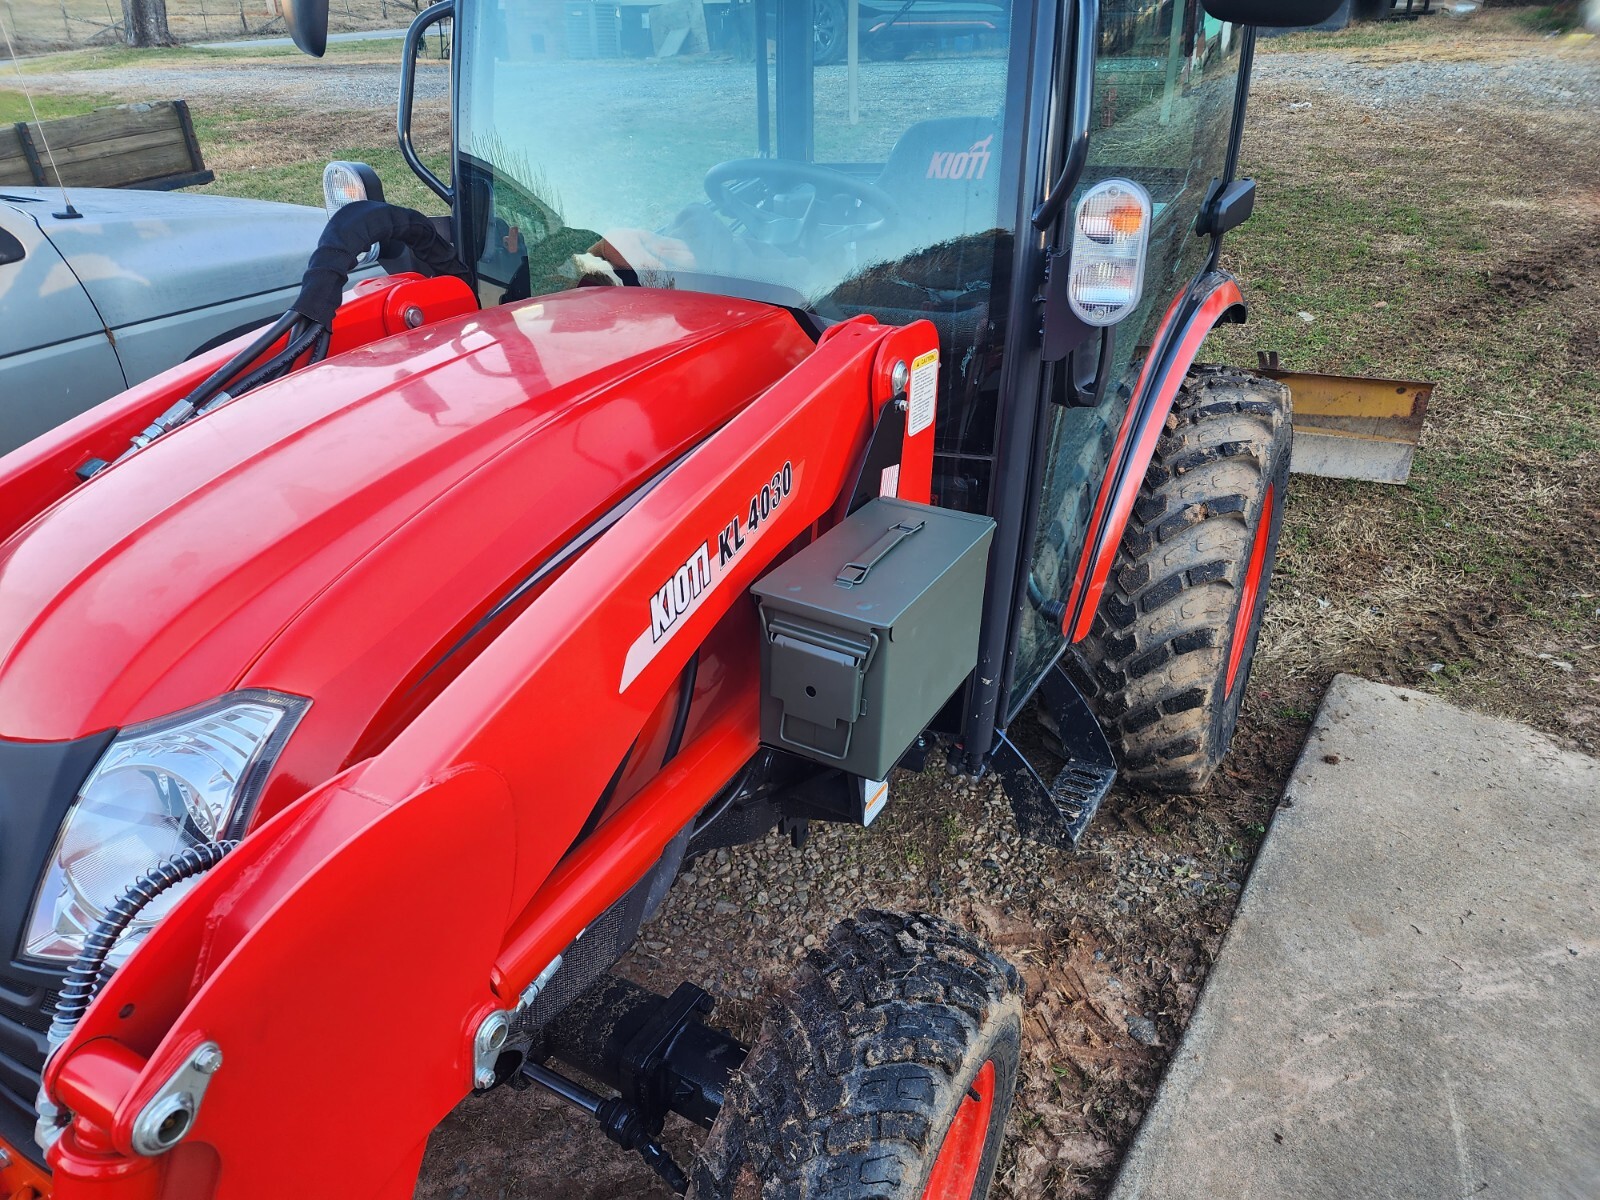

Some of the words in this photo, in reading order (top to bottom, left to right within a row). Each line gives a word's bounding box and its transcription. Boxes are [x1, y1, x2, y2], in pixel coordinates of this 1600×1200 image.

[926, 150, 991, 179] KIOTI
[650, 540, 711, 643] KIOTI
[717, 515, 745, 571] KL
[747, 460, 793, 534] 4030
